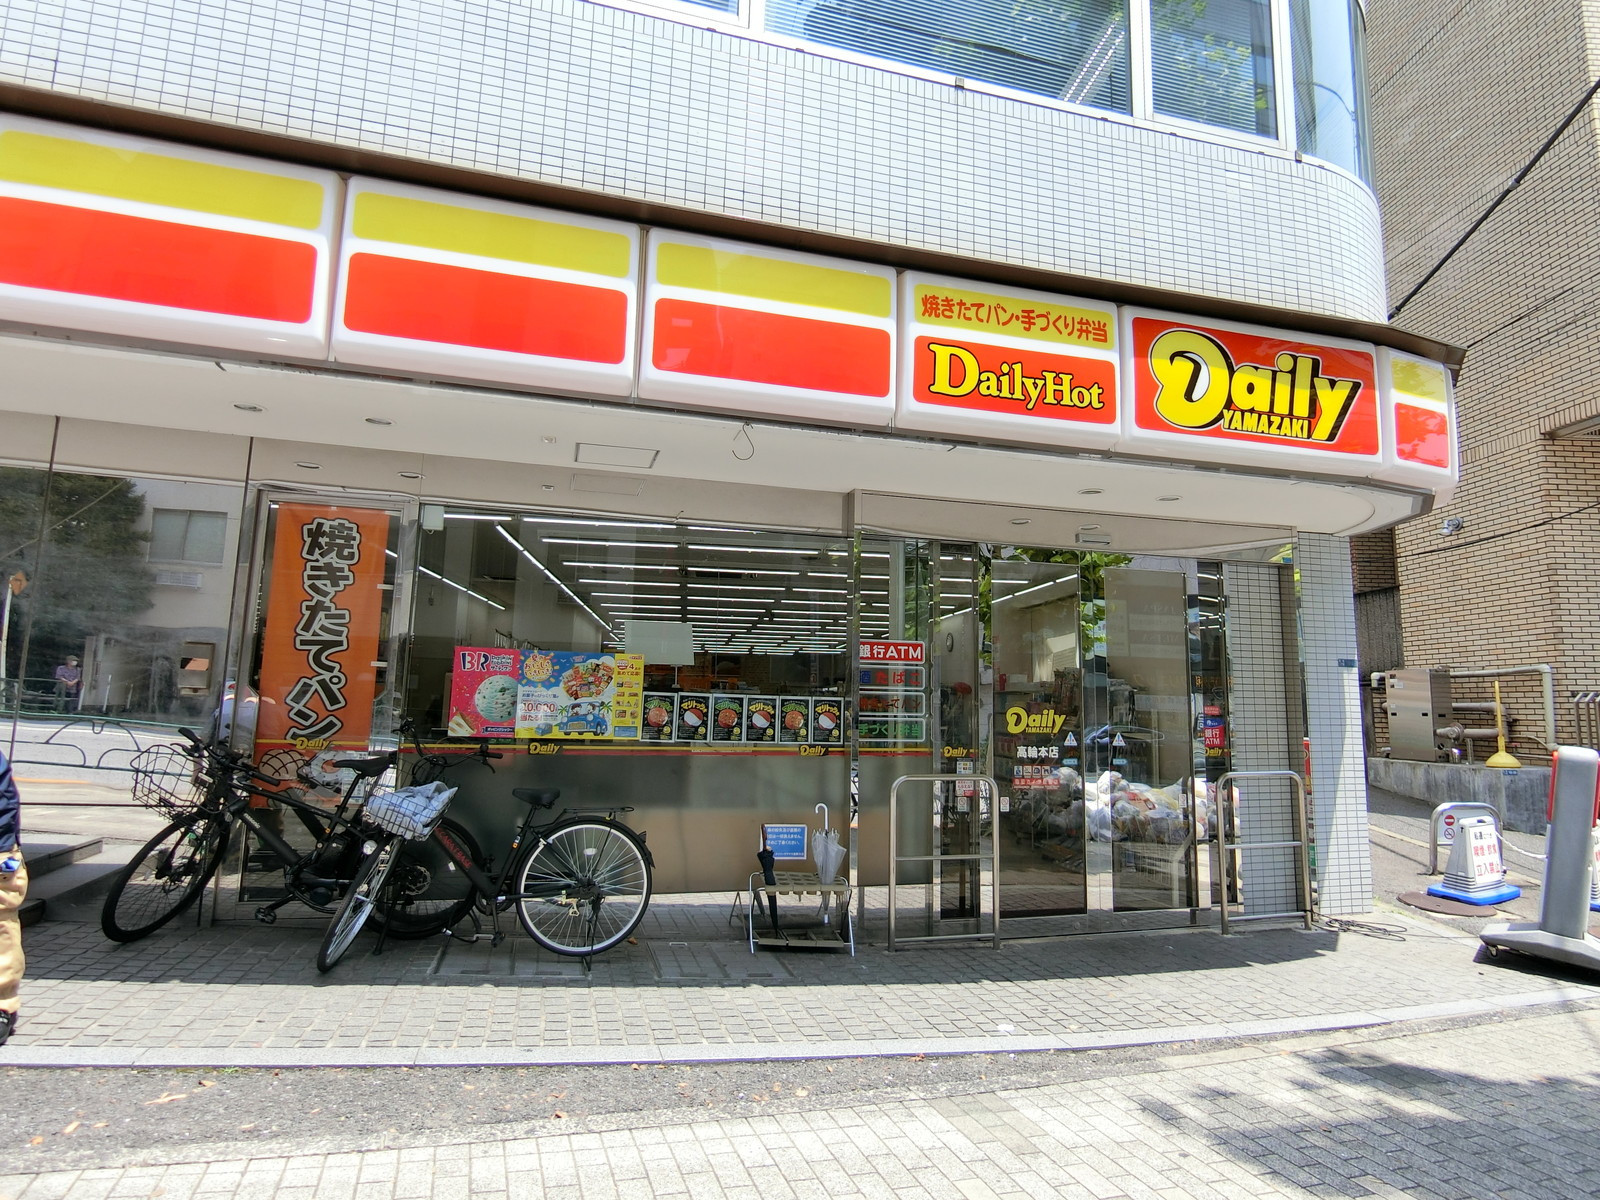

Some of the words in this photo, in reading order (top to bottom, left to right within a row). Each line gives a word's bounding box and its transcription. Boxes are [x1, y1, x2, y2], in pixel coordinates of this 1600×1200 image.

[921, 293, 1109, 344] 焼きたてパン・手づくり弁当
[1149, 329, 1363, 443] Daily
[1223, 409, 1310, 440] YAMAZAKI
[285, 517, 361, 742] 焼きたてパン
[859, 644, 921, 660] 銀行ATM
[1005, 706, 1067, 734] Daily
[1204, 729, 1220, 738] 銀行
[295, 736, 330, 750] Daily
[529, 742, 560, 755] Daily
[800, 744, 827, 756] Daily
[943, 746, 968, 757] Daily
